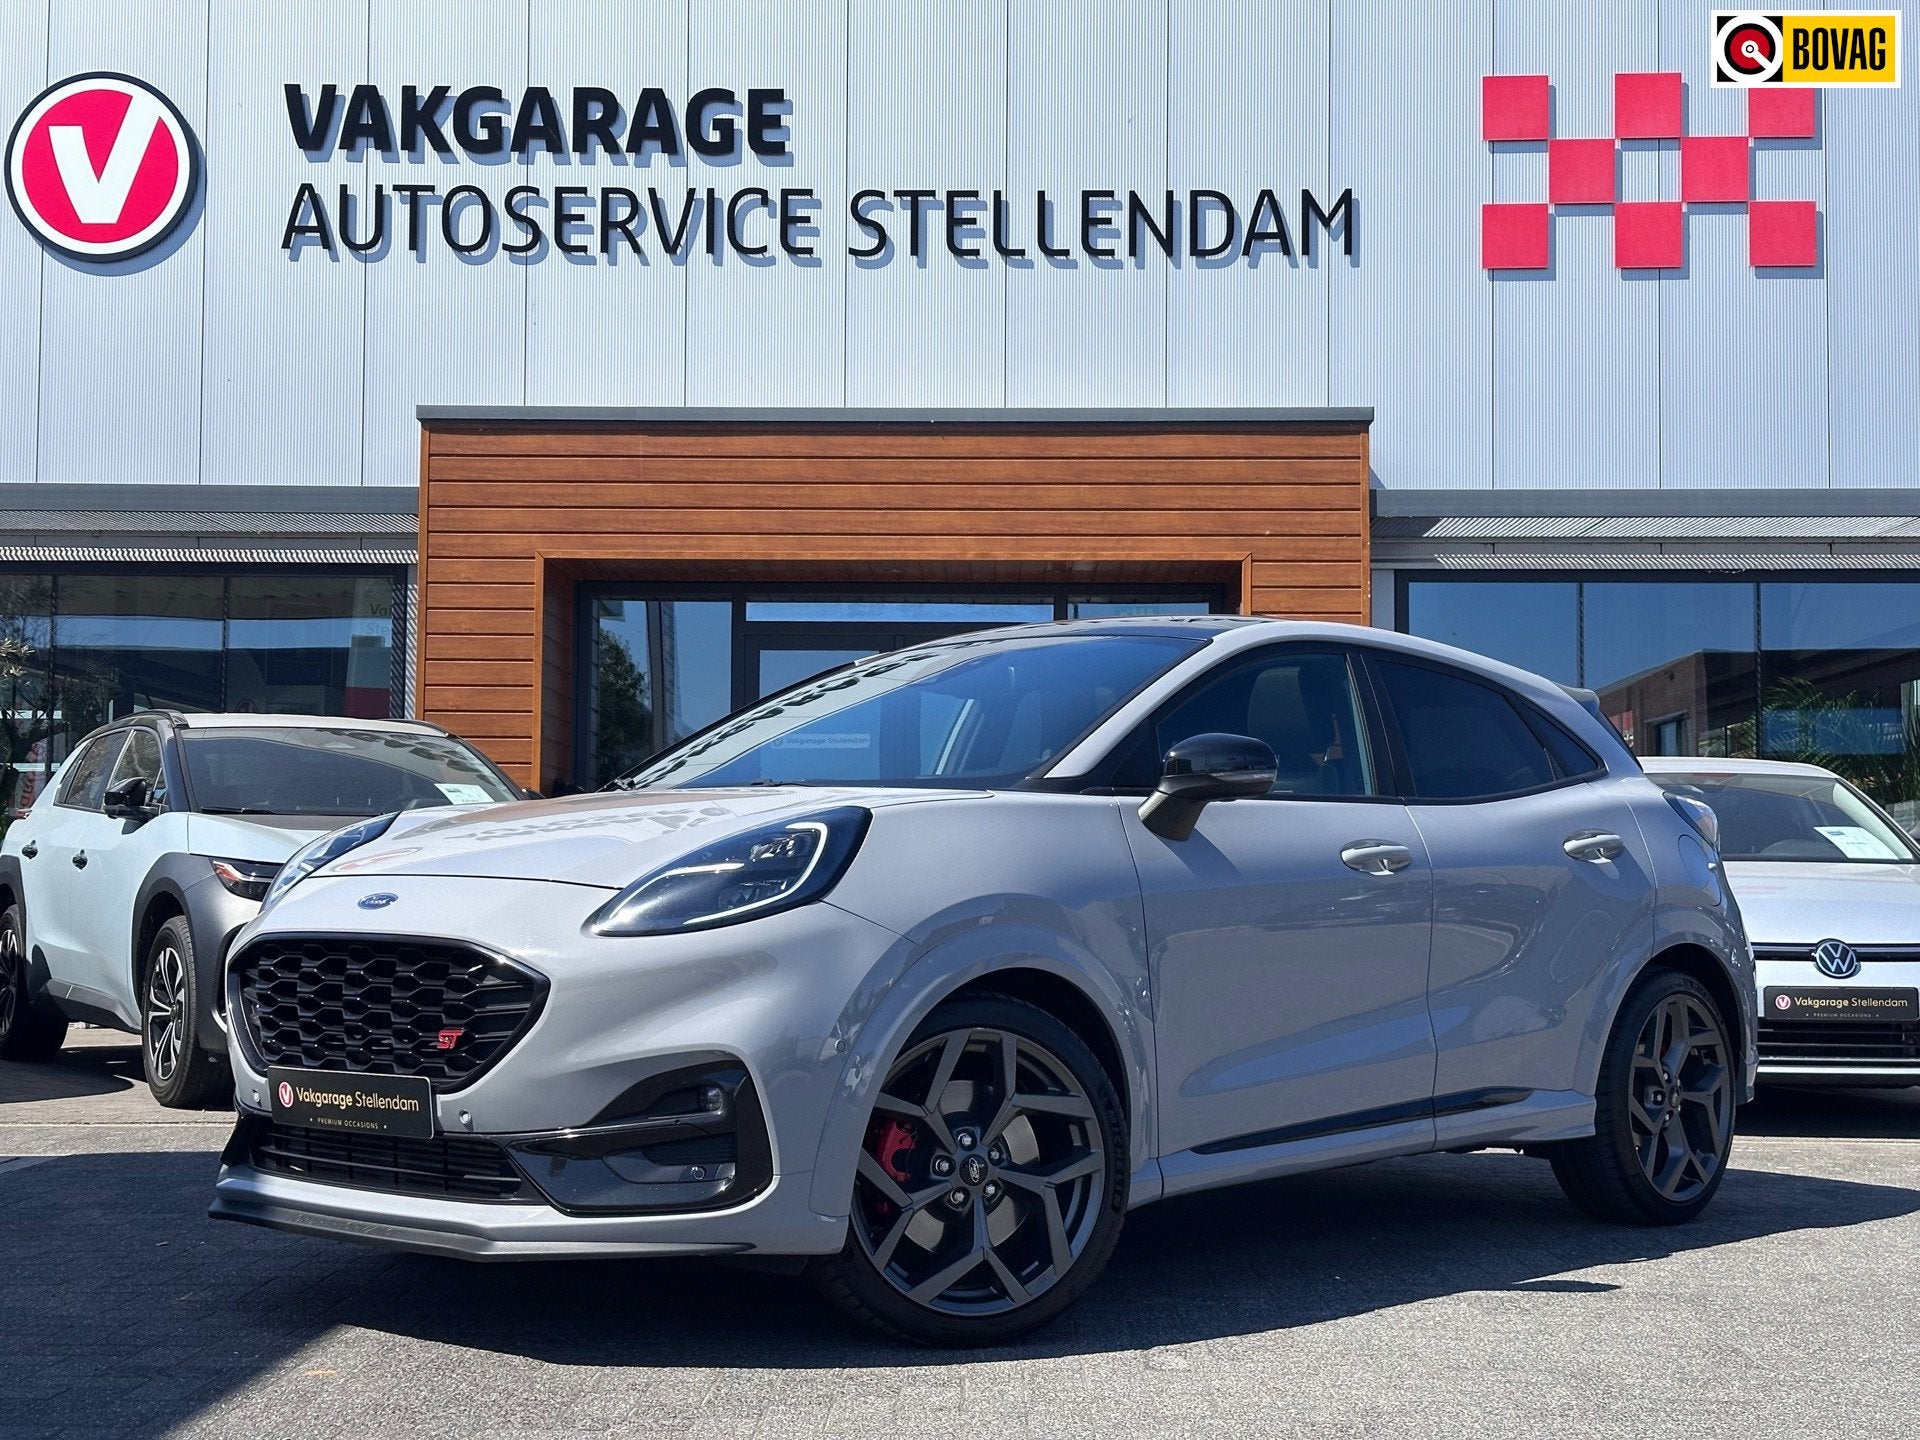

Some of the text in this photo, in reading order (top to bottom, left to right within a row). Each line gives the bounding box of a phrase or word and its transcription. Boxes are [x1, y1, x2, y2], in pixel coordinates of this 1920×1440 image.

[283, 83, 786, 156] VAKGARAGE
[48, 90, 161, 225] V
[281, 182, 1354, 258] AUTOSERVICE STELLENDAM
[1794, 996, 1849, 1009] Vakgarage
[1851, 997, 1908, 1007] Stellendam
[436, 1029, 466, 1050] ST
[295, 1086, 353, 1109] Vakgarage
[355, 1091, 419, 1112] Stellendam
[317, 1117, 379, 1130] PREMIUM OCCASIONS
